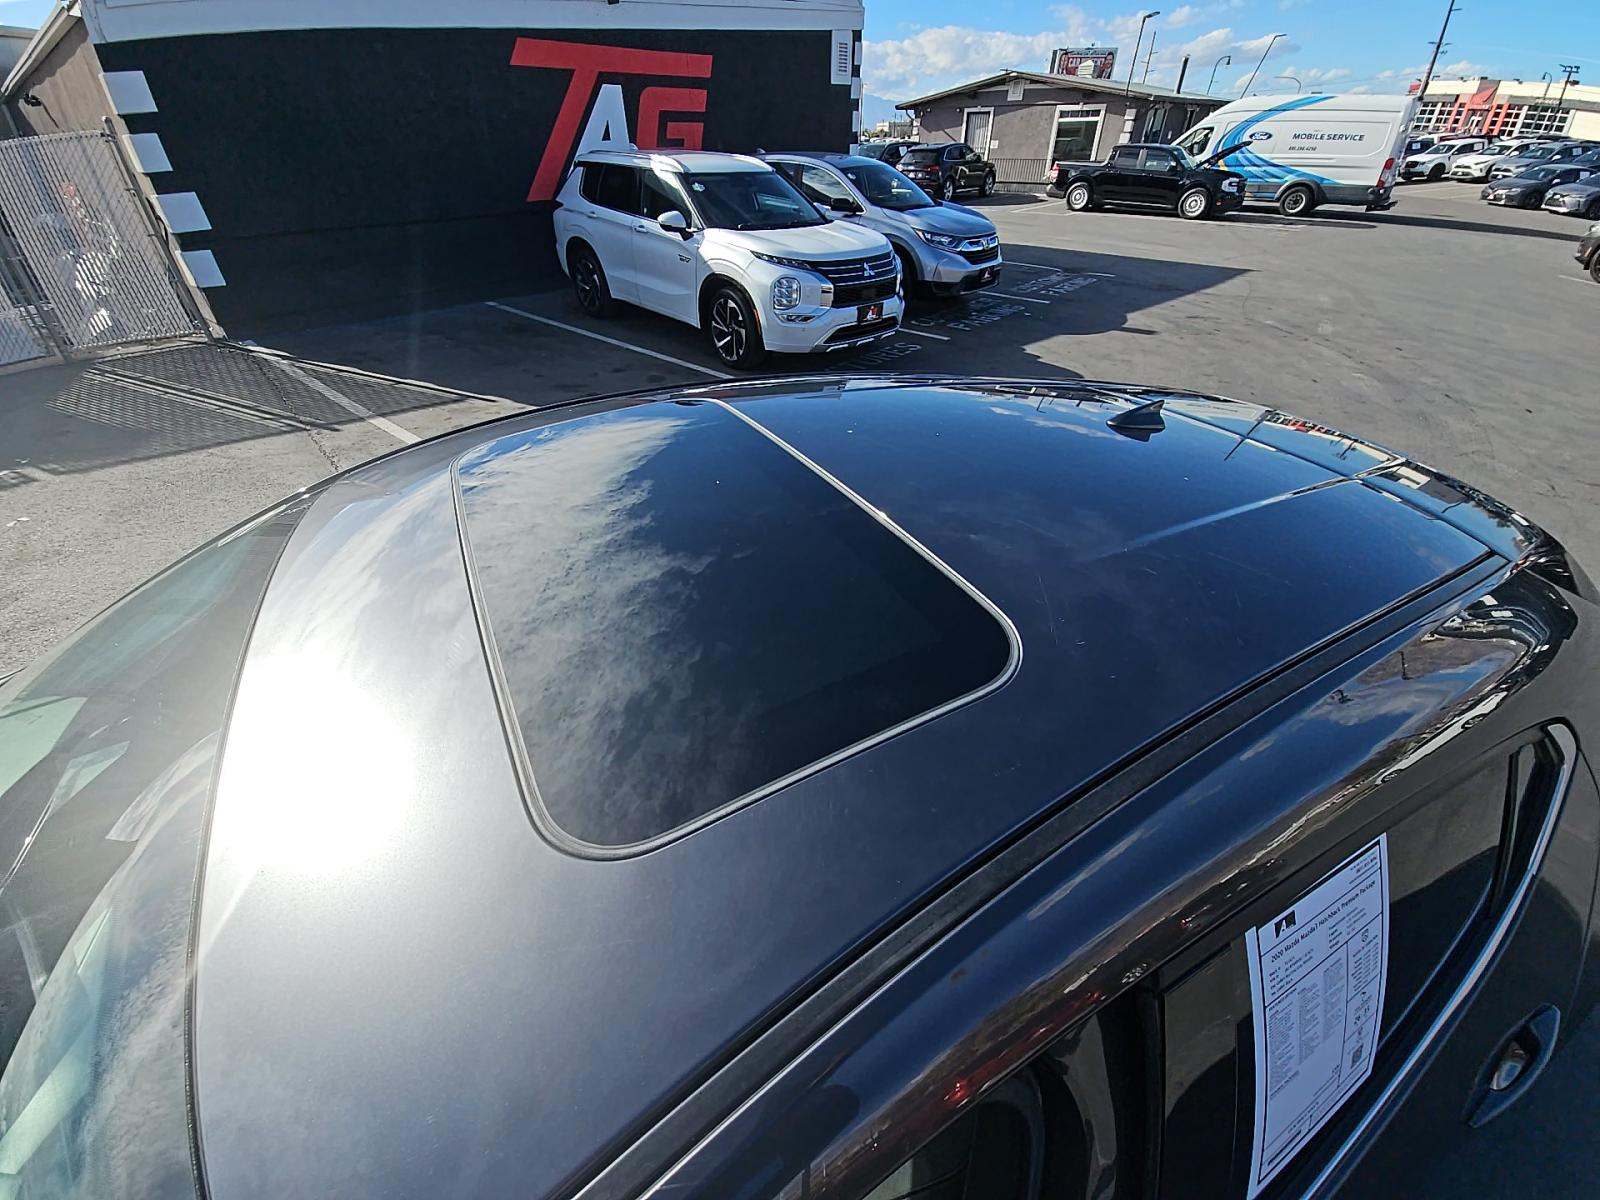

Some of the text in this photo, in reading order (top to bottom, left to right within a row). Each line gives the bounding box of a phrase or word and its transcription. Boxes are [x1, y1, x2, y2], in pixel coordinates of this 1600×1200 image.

[509, 37, 713, 203] TAG
[1292, 133, 1365, 142] MOBILE SERVICE
[1284, 938, 1300, 952] Mazda
[1359, 880, 1376, 895] Package
